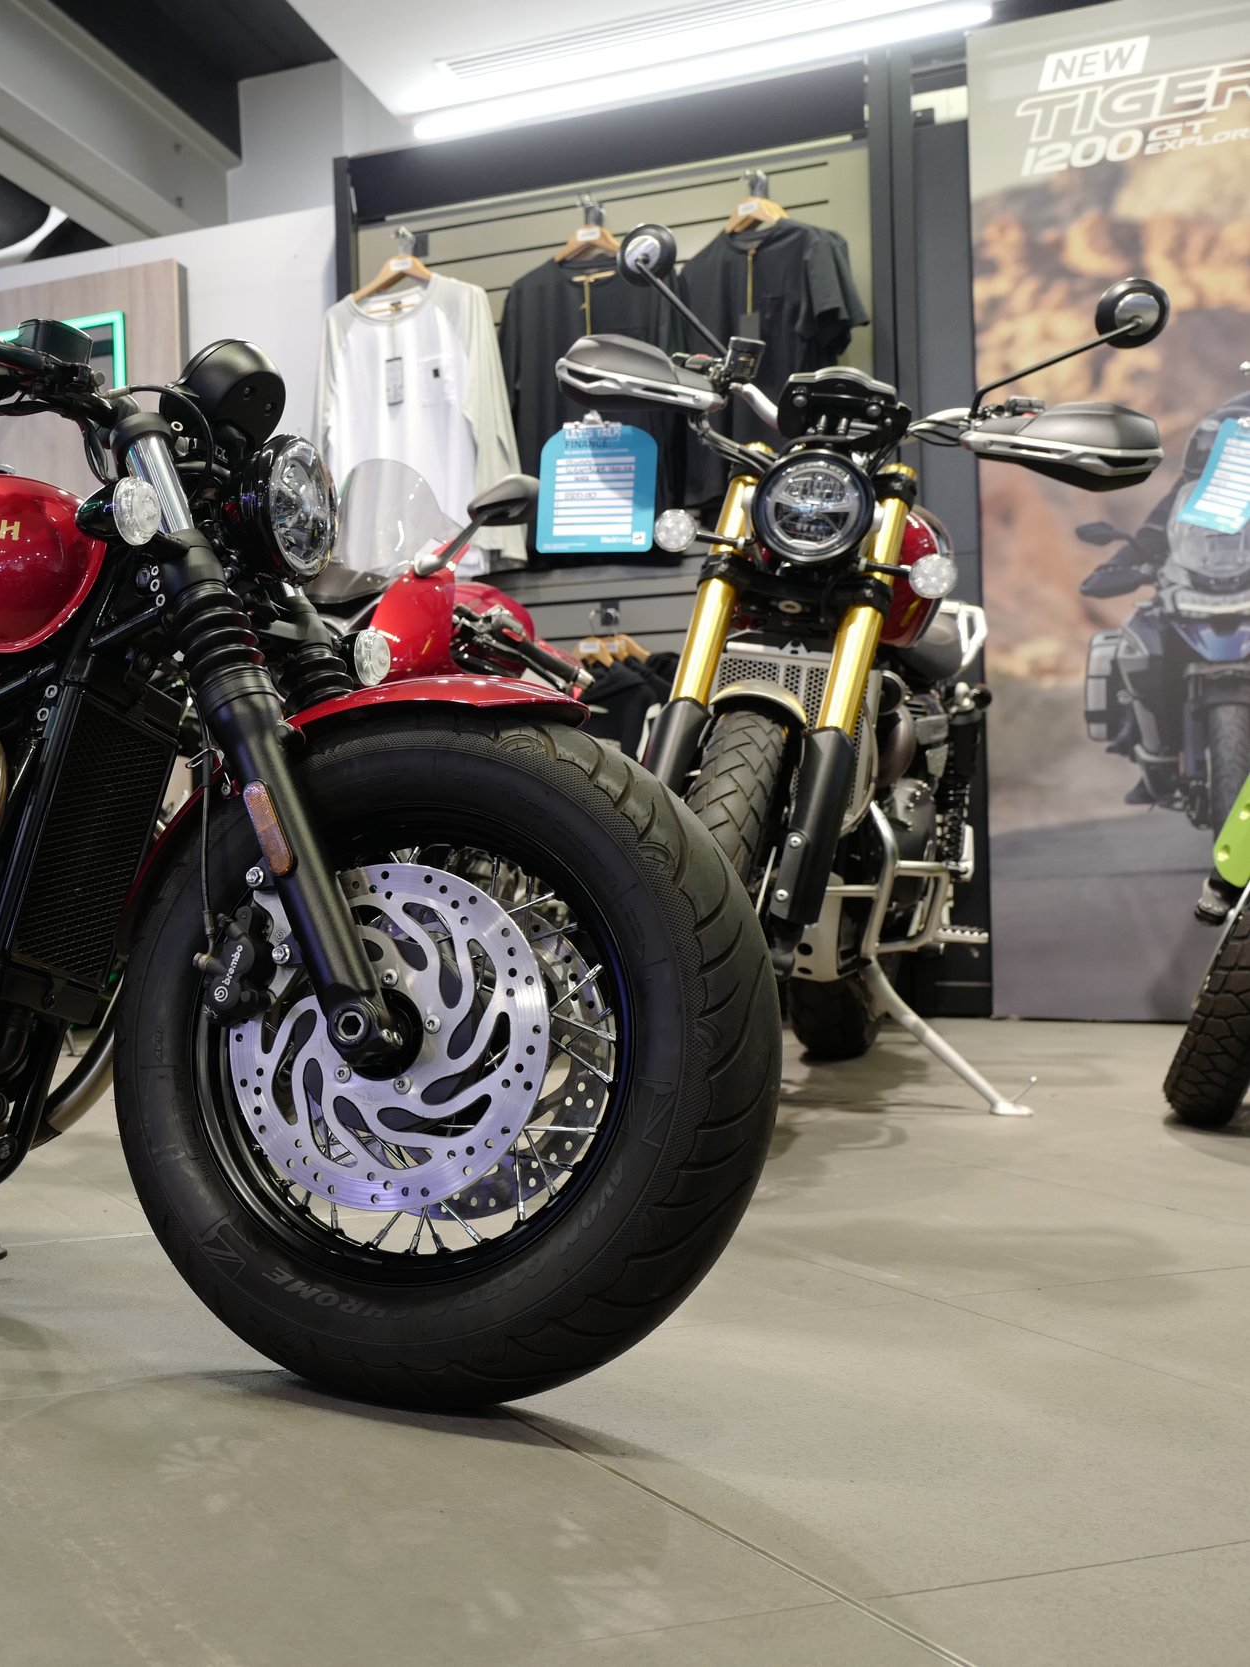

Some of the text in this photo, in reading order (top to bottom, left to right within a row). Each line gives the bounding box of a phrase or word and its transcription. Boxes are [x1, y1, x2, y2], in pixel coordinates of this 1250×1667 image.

[1052, 44, 1137, 83] NEW
[1021, 117, 1217, 177] 1200 GT
[221, 944, 243, 986] brembo
[559, 1154, 623, 1256] AVON
[261, 1266, 414, 1320] CHROME
